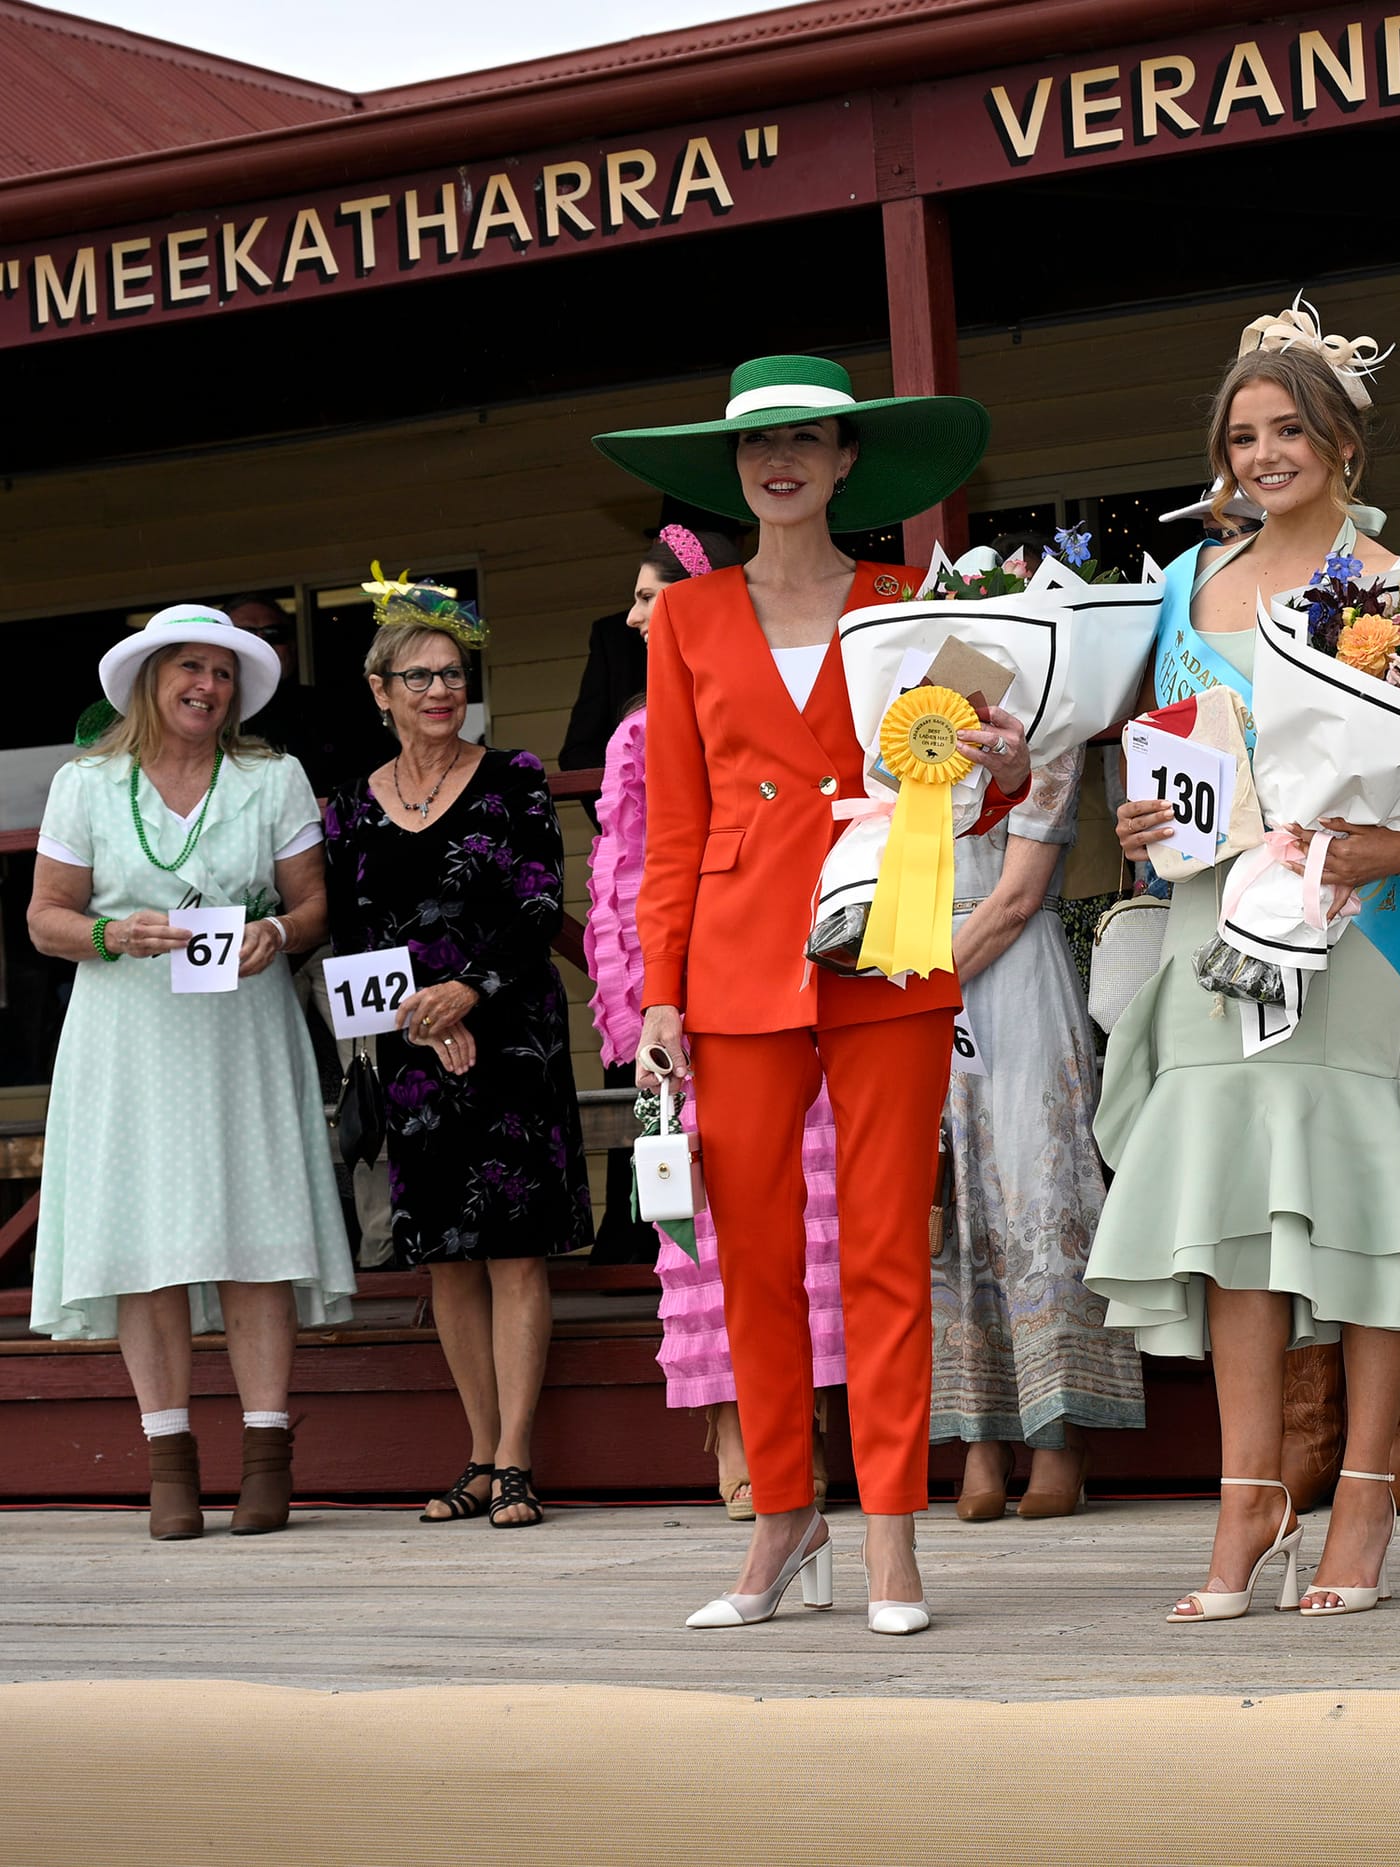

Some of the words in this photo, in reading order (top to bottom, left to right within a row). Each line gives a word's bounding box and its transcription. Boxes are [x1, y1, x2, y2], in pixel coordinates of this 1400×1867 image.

[1152, 766, 1215, 834] 130
[186, 932, 234, 967] 67
[334, 971, 409, 1017] 142
